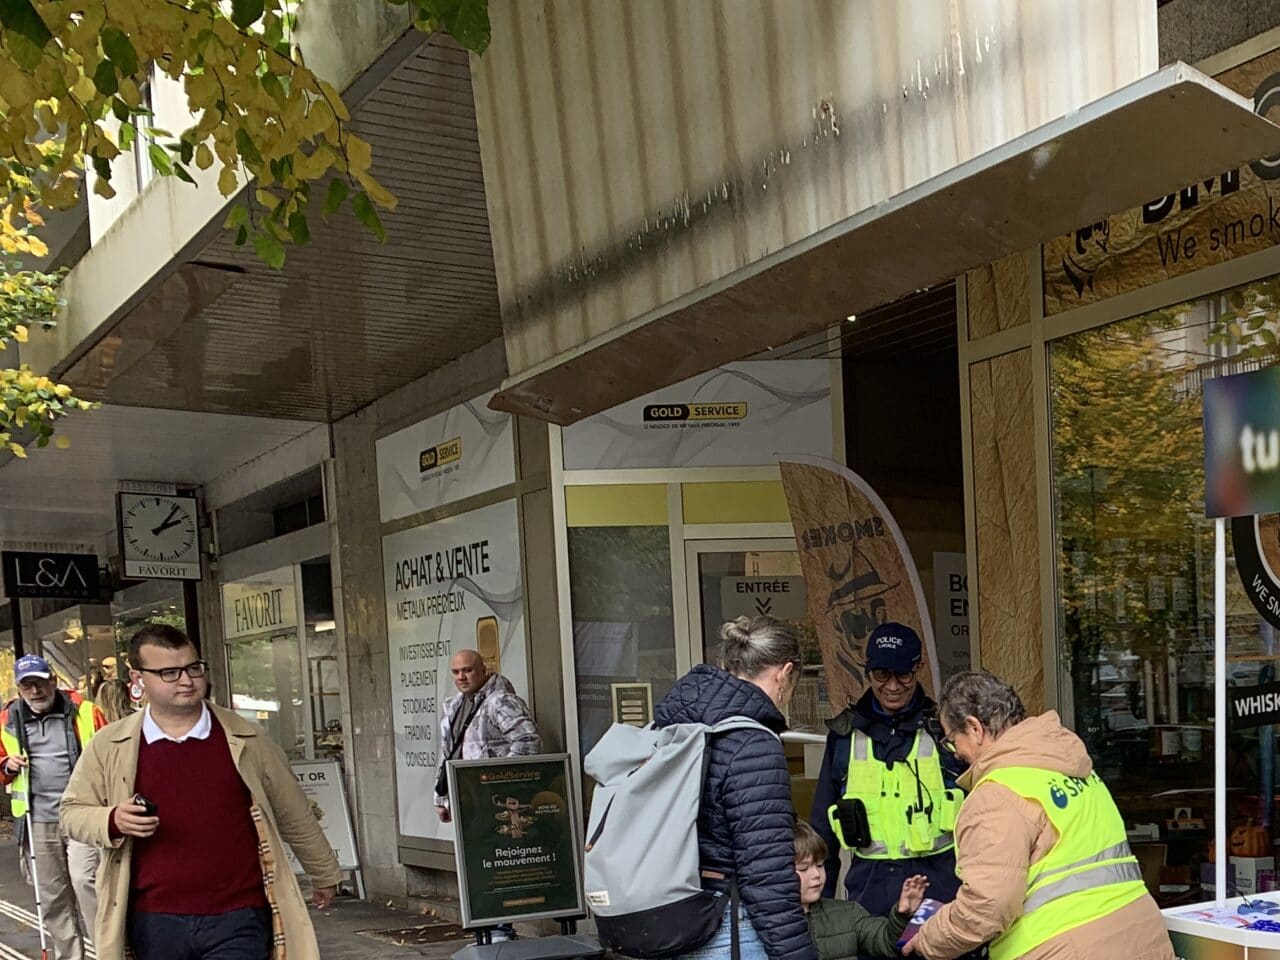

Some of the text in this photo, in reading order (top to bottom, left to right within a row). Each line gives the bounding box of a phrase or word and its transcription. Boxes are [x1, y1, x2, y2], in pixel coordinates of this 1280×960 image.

[1157, 230, 1197, 268] We
[650, 405, 740, 418] GOLD SERVICE
[438, 442, 459, 461] SERVICE
[1240, 424, 1280, 473] tu
[138, 565, 188, 577] FAVORIT
[395, 540, 491, 592] ACHAT & VENTE
[736, 579, 791, 593] ENTRÉE
[1252, 573, 1270, 603] WE
[235, 588, 283, 633] FAVORIT
[396, 590, 467, 621] MÉTAUX PRÉCIEUX
[876, 636, 903, 646] POLICE
[399, 640, 452, 662] INVESTISSEMENT
[400, 669, 438, 688] PLACEMENT
[402, 697, 436, 716] STOCKAGE
[404, 725, 432, 742] TRADING
[405, 749, 436, 768] CONSEILS
[308, 772, 326, 781] OR
[494, 845, 543, 859] Rejoignez
[482, 859, 492, 869] le
[494, 855, 551, 868] mouvement
